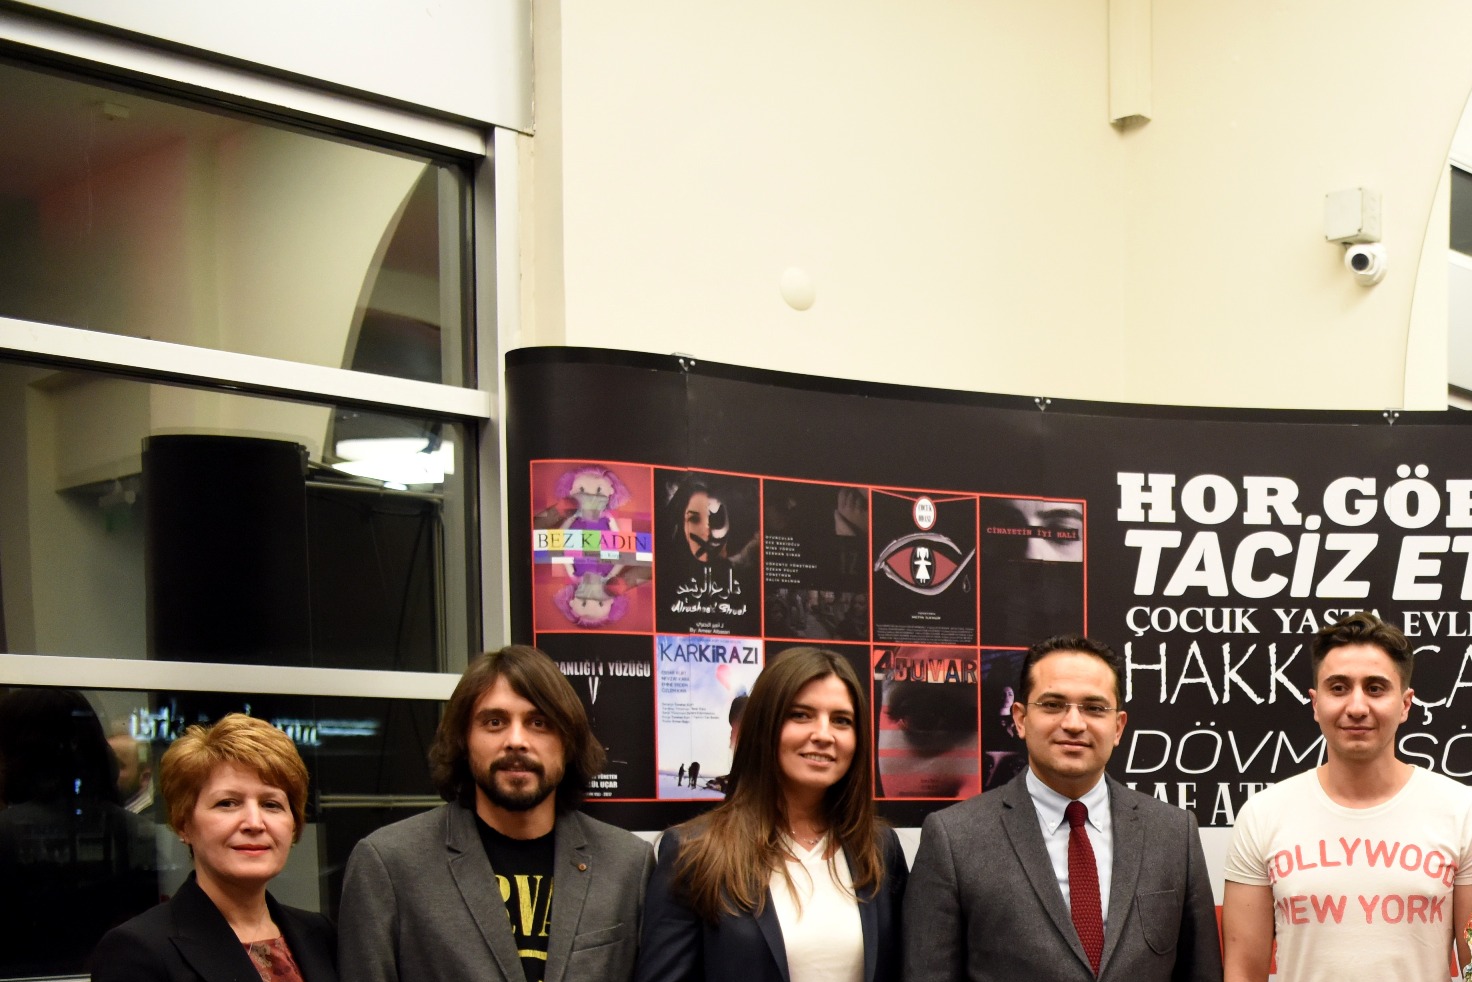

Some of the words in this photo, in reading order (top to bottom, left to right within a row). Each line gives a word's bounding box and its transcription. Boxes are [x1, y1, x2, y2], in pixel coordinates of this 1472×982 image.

[1117, 472, 1302, 526] HOR
[538, 533, 575, 549] BEZ
[1124, 514, 1379, 599] TACİZ
[1126, 606, 1260, 637] ÇOCUK
[1277, 894, 1348, 926] NEW
[1358, 894, 1447, 925] YORK
